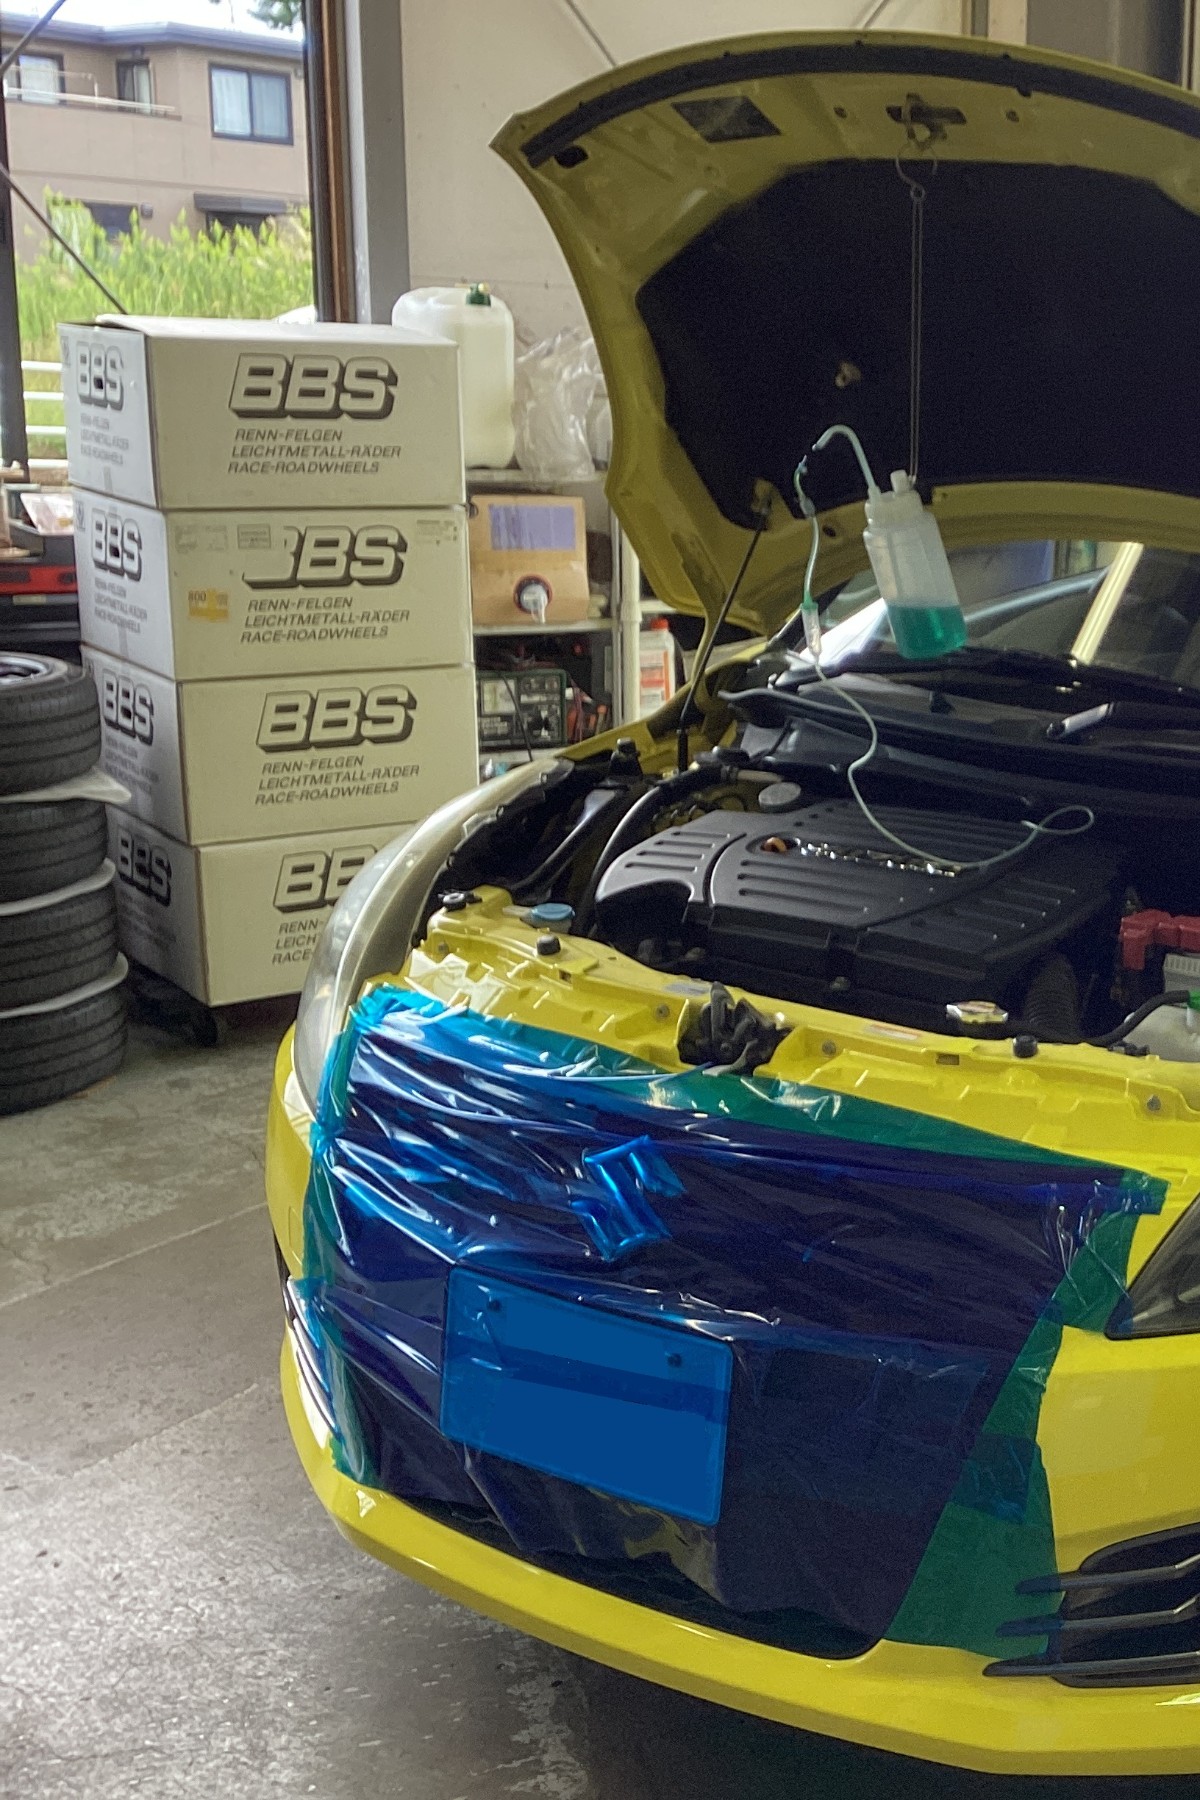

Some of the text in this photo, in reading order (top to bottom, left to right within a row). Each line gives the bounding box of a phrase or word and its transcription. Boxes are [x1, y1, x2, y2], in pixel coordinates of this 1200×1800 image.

[76, 341, 124, 411] BBS
[228, 353, 398, 420] BBS
[235, 428, 342, 442] RENN-FELGEN
[231, 444, 402, 459] LEICHTMETALL-RÄDER
[228, 461, 380, 475] RACE-ROADWHEELS
[91, 507, 143, 582] BBS
[247, 597, 353, 613] RENN-FELGEN
[244, 610, 410, 629] LEICHTMETALL-RÄDER
[240, 626, 389, 643] RACE-ROADWHEELS
[102, 668, 154, 746] BBS
[256, 684, 418, 754] BBS
[262, 755, 365, 775] RENN-FELGEN
[258, 764, 420, 791] LEICHTMETALL-RÄDER
[255, 781, 399, 805] RACE-ROADWHEELS
[117, 824, 172, 907] BBS
[275, 933, 322, 950] LEICH
